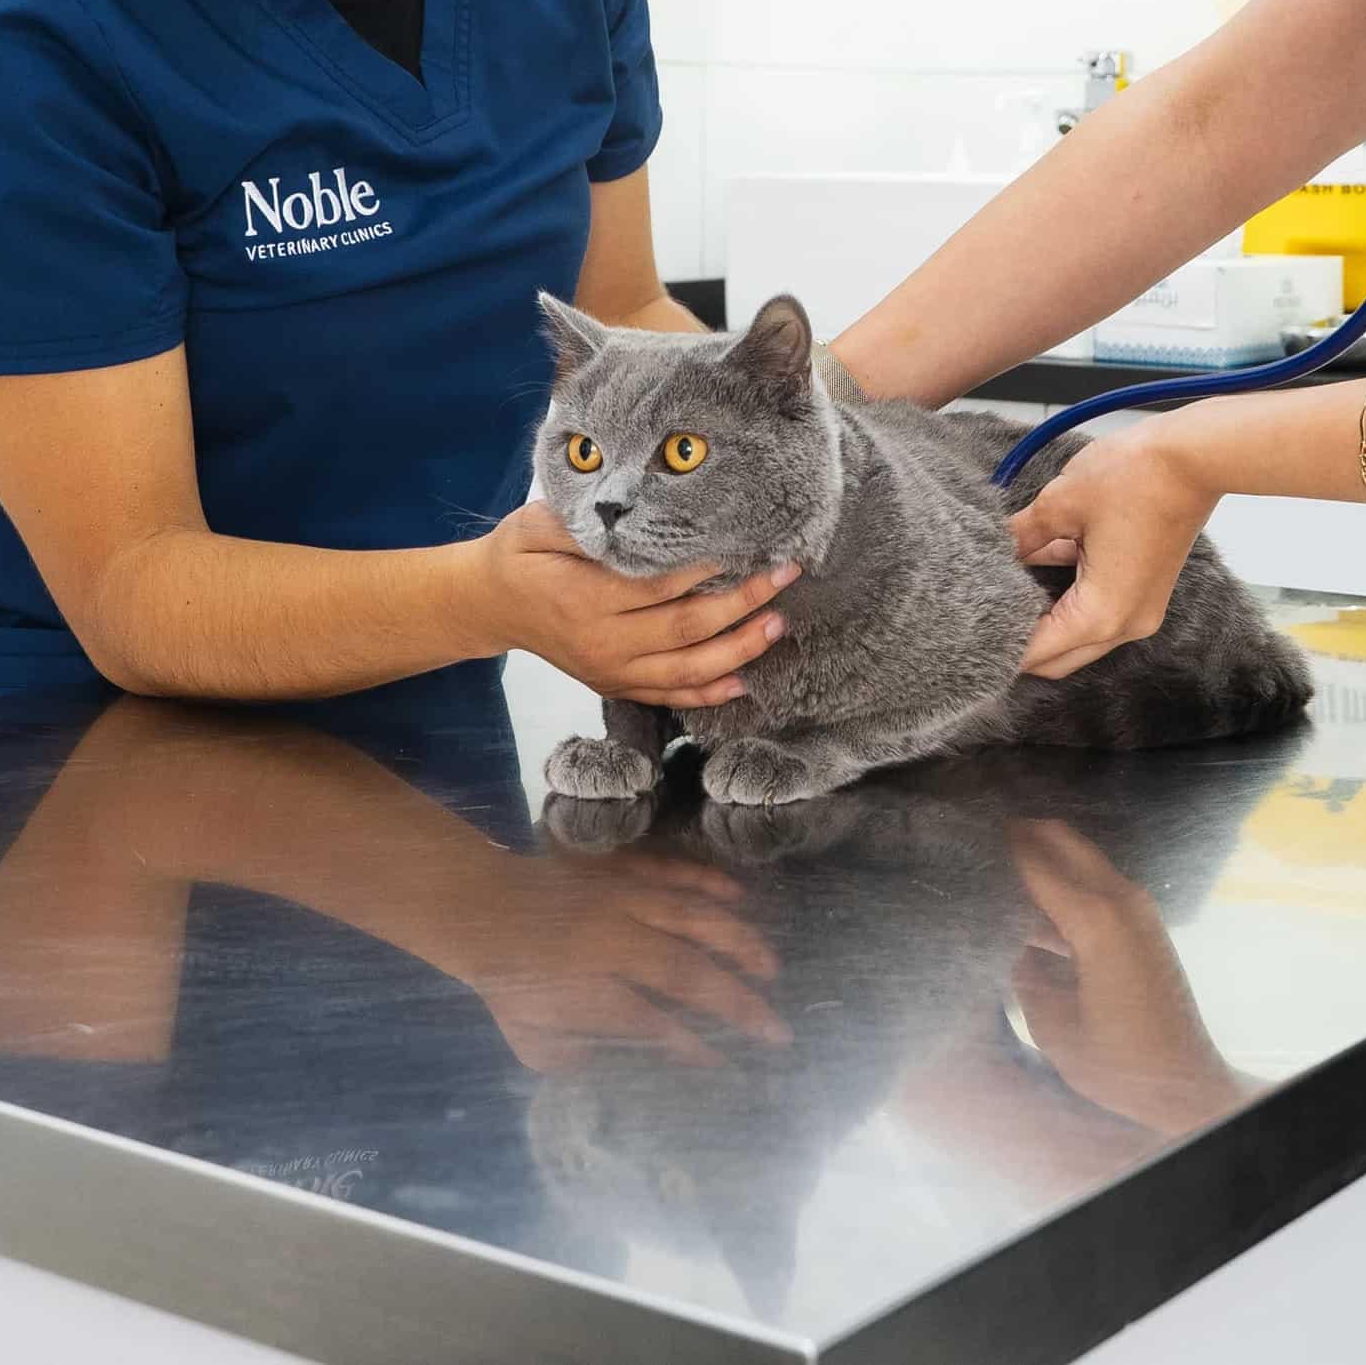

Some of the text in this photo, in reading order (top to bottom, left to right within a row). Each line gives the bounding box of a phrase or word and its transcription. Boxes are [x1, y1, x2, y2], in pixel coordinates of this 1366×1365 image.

[241, 167, 380, 237] Noble
[245, 222, 393, 262] VETERINARY CLINICS
